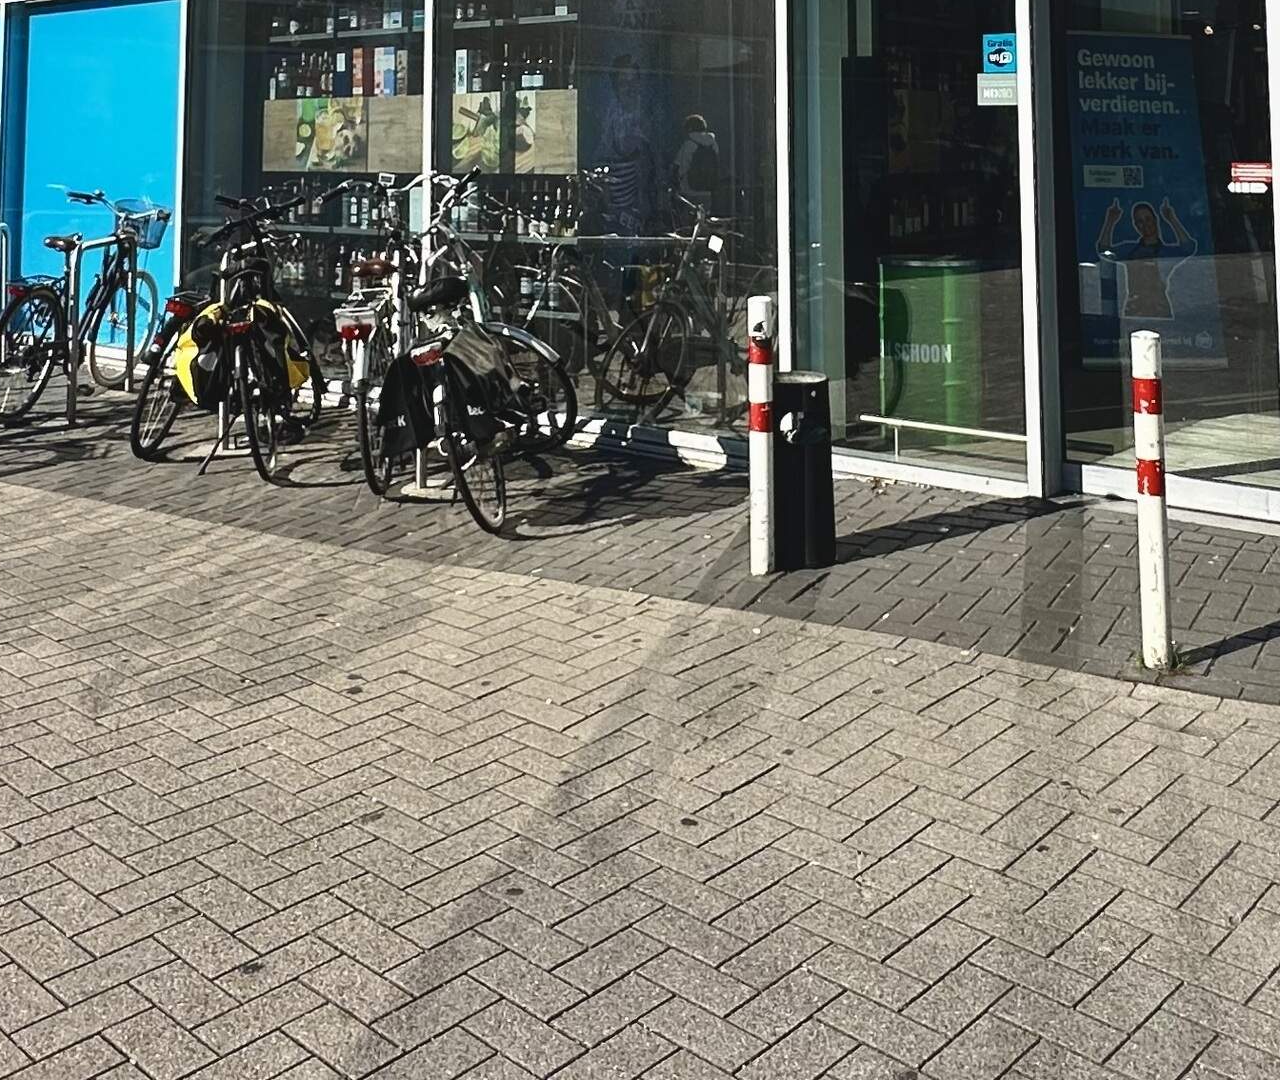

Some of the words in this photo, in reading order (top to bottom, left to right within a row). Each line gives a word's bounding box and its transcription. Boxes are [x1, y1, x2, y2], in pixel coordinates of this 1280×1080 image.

[1077, 48, 1155, 69] Gewoon
[1078, 71, 1138, 91] lekker
[1144, 73, 1176, 95] bij-
[1079, 95, 1181, 115] verdienen.
[1081, 119, 1135, 137] Maak
[1142, 123, 1162, 137] er
[1082, 142, 1132, 160] werk
[1139, 145, 1179, 160] van.
[894, 342, 952, 364] SCHOON
